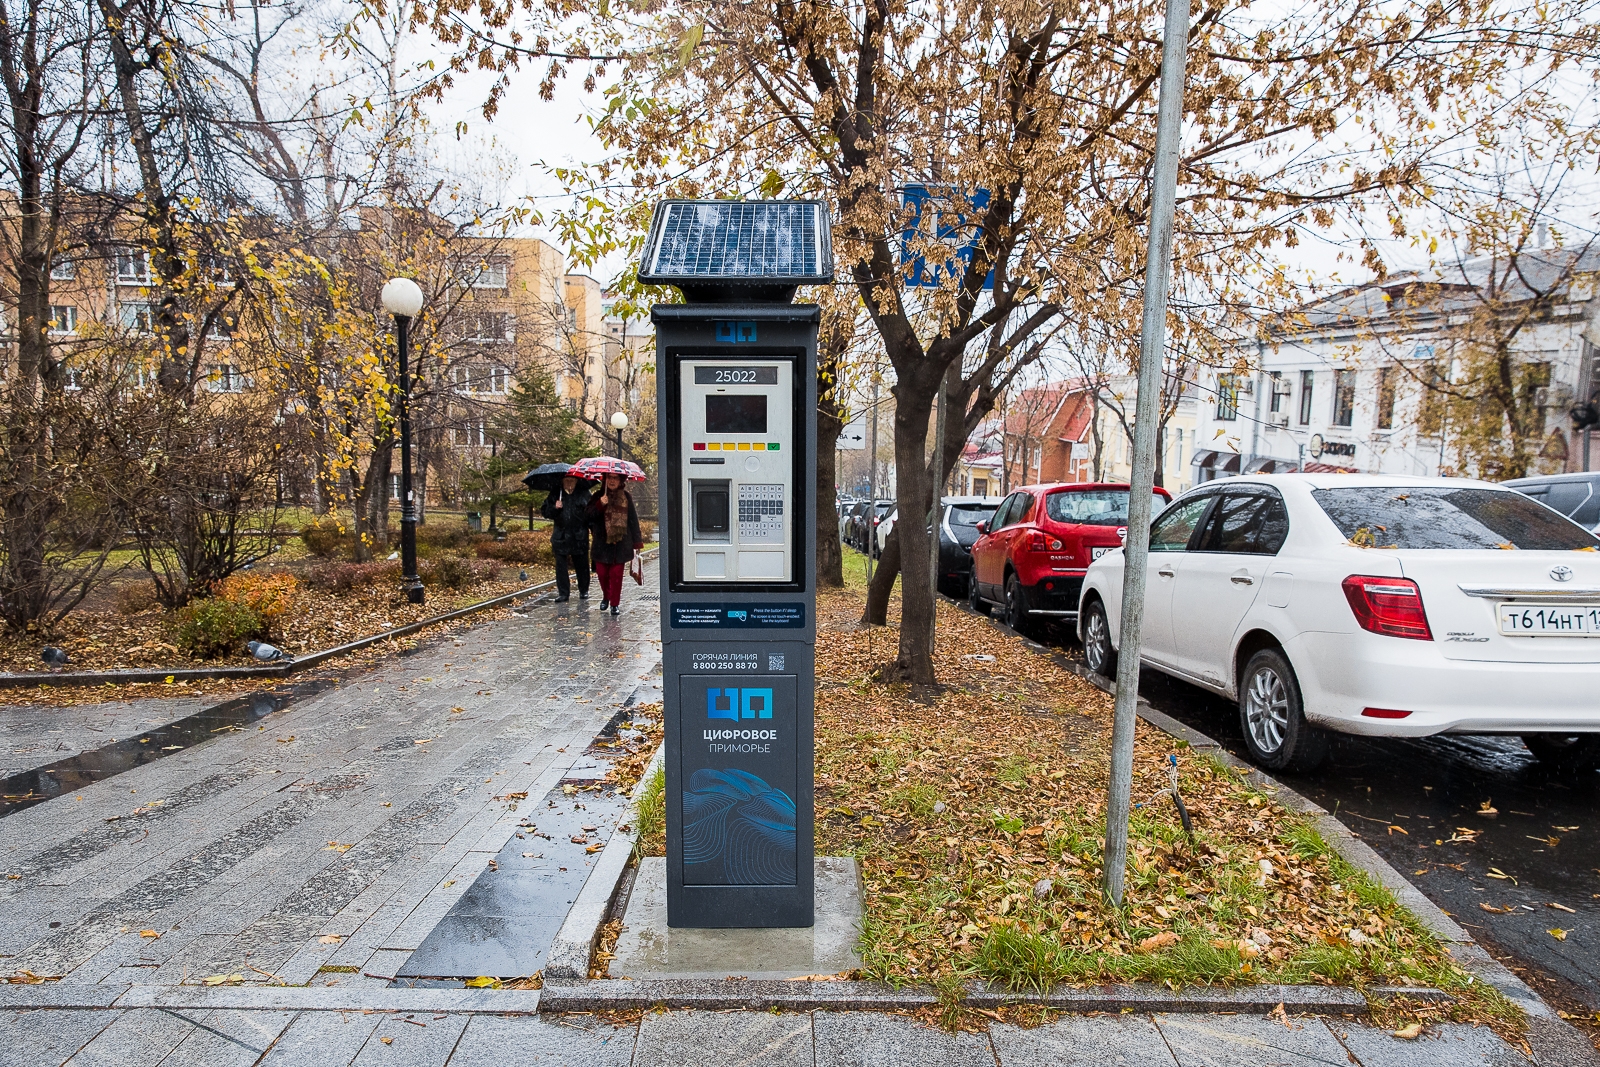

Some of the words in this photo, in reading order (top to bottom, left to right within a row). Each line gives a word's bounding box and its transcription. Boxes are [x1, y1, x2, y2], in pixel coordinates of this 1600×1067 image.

[715, 370, 757, 382] 25022
[1589, 609, 1600, 624] 1
[692, 653, 728, 661] ГОРЯЧАЯ
[730, 653, 758, 661] ЛИНИЯ
[703, 730, 777, 741] ЦИФРОВОЕ
[709, 744, 771, 753] ПРИМОРЬЕ
